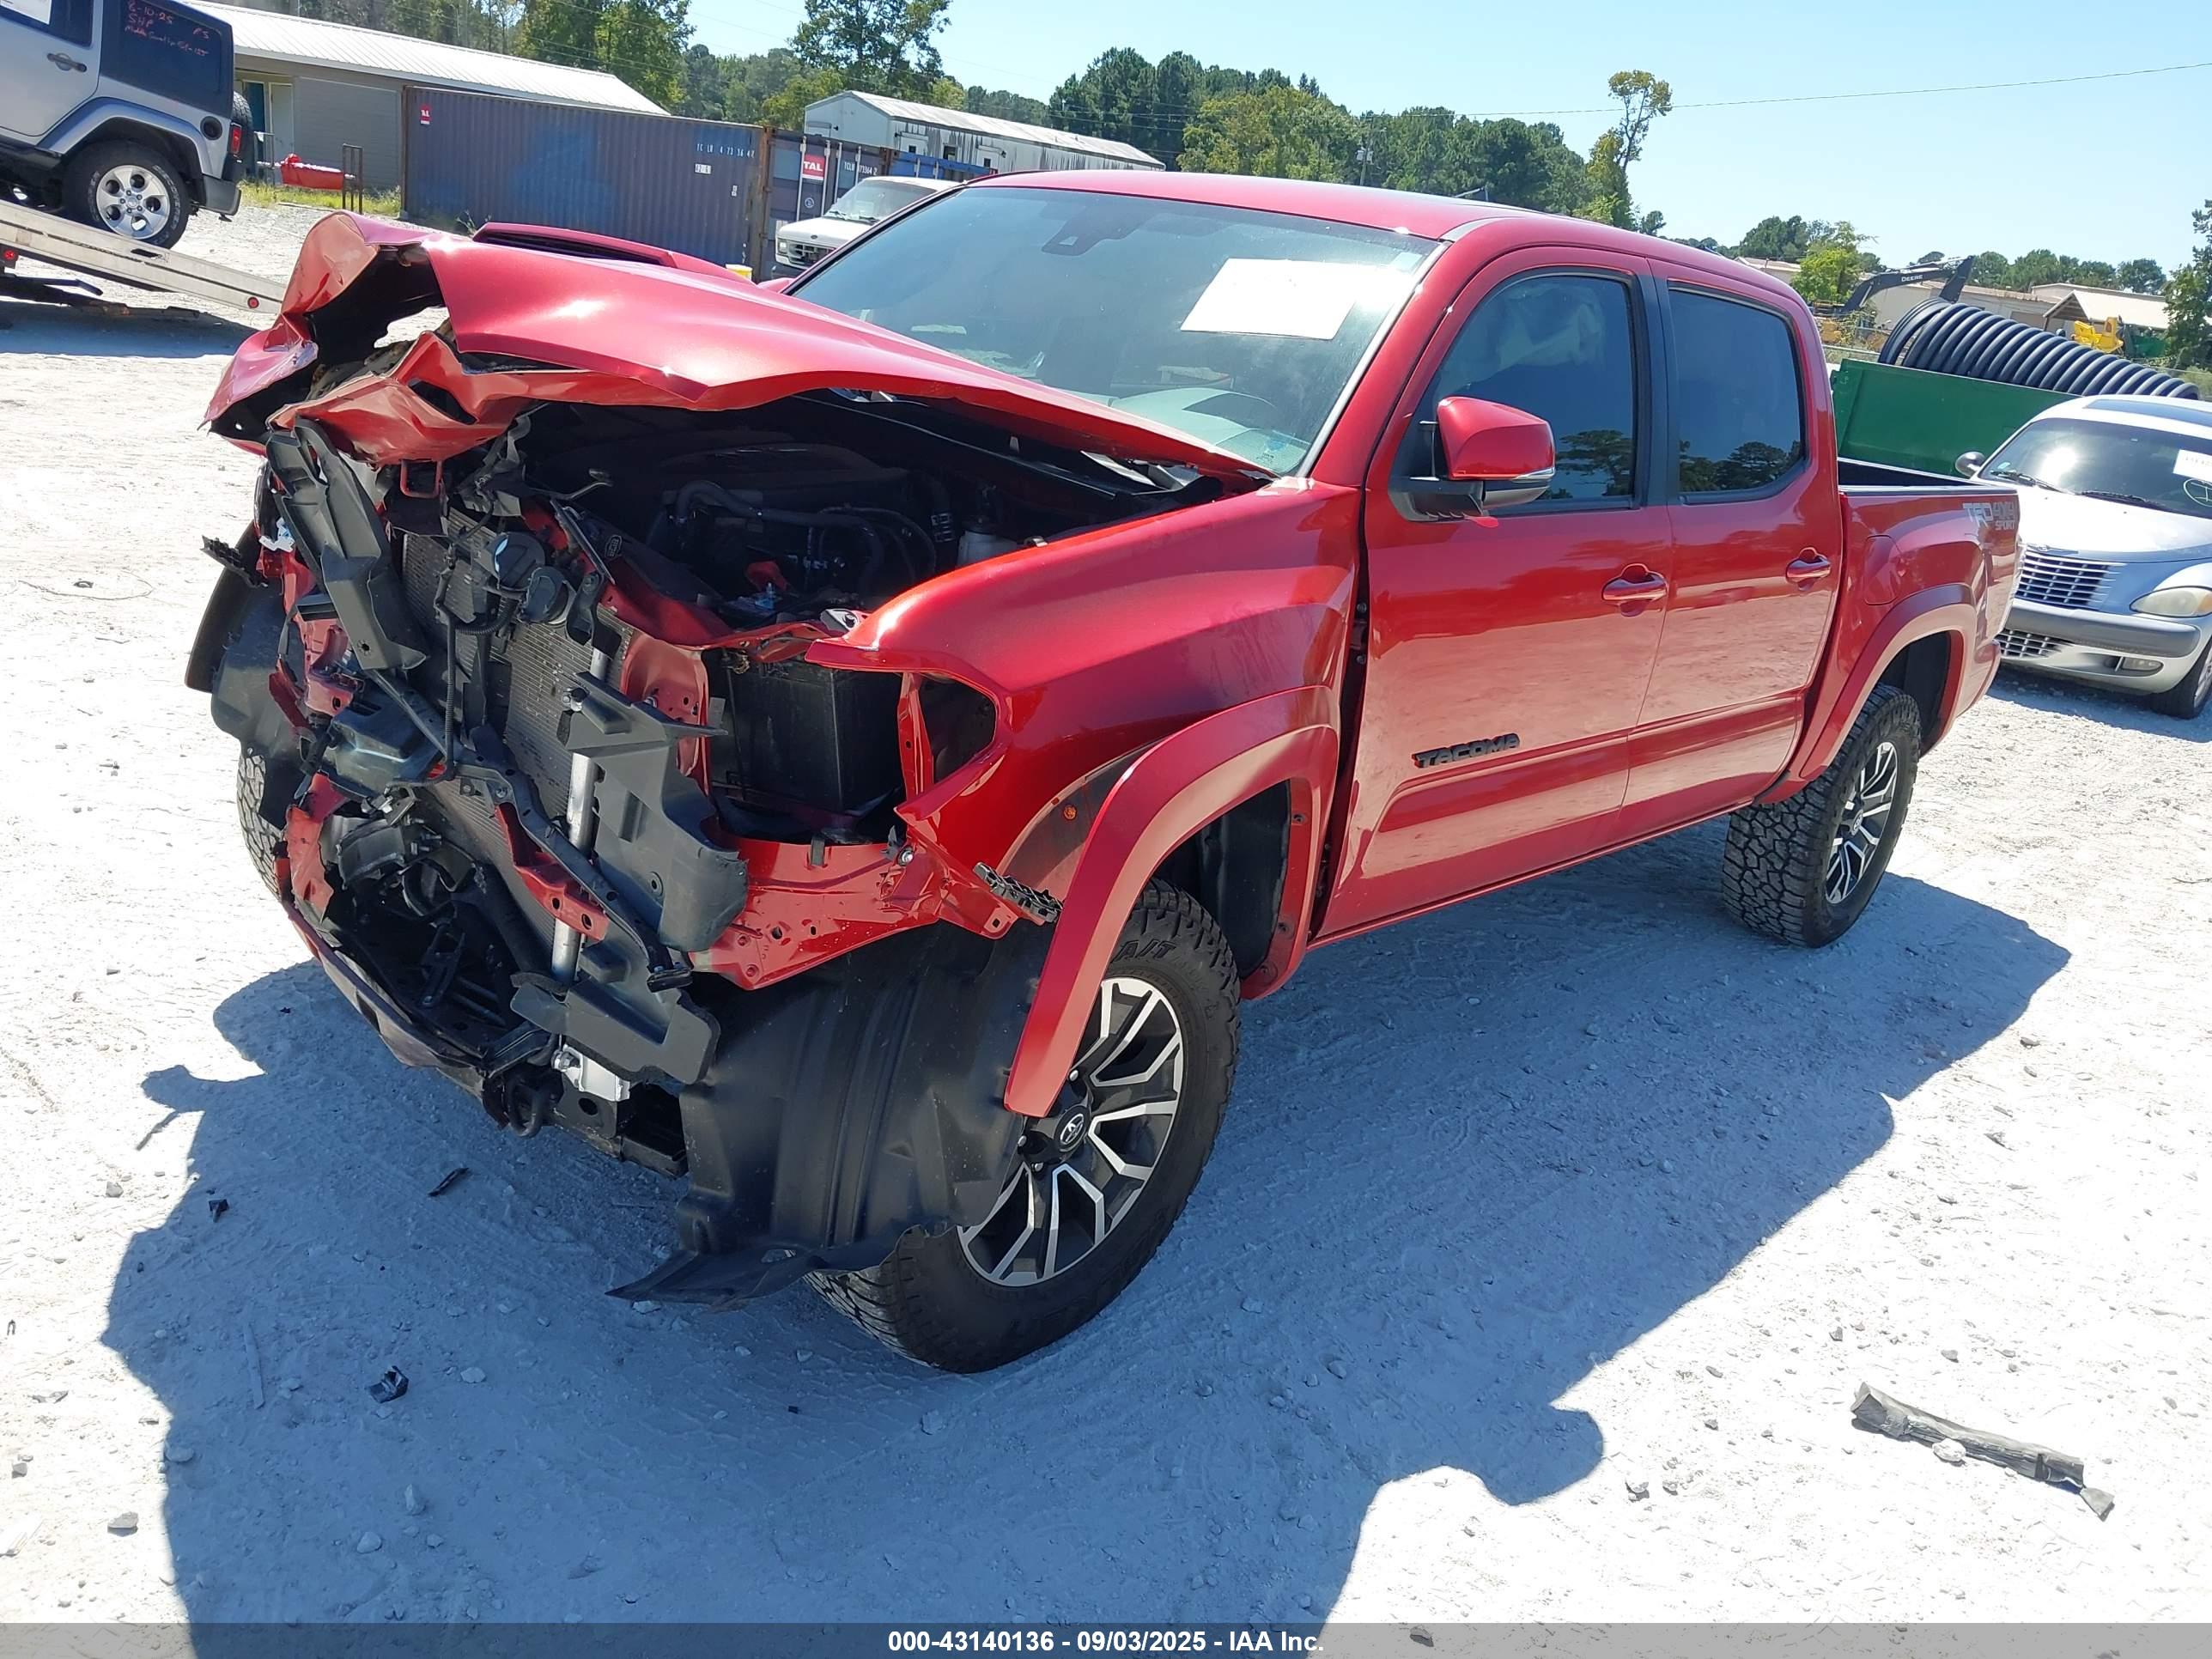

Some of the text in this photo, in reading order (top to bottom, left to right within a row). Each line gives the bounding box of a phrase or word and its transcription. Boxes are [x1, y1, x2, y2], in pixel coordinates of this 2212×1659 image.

[803, 161, 823, 172] TAL
[1901, 274, 1923, 283] DEERE
[1962, 502, 1993, 529] TRD
[1411, 732, 1520, 769] TACOMA
